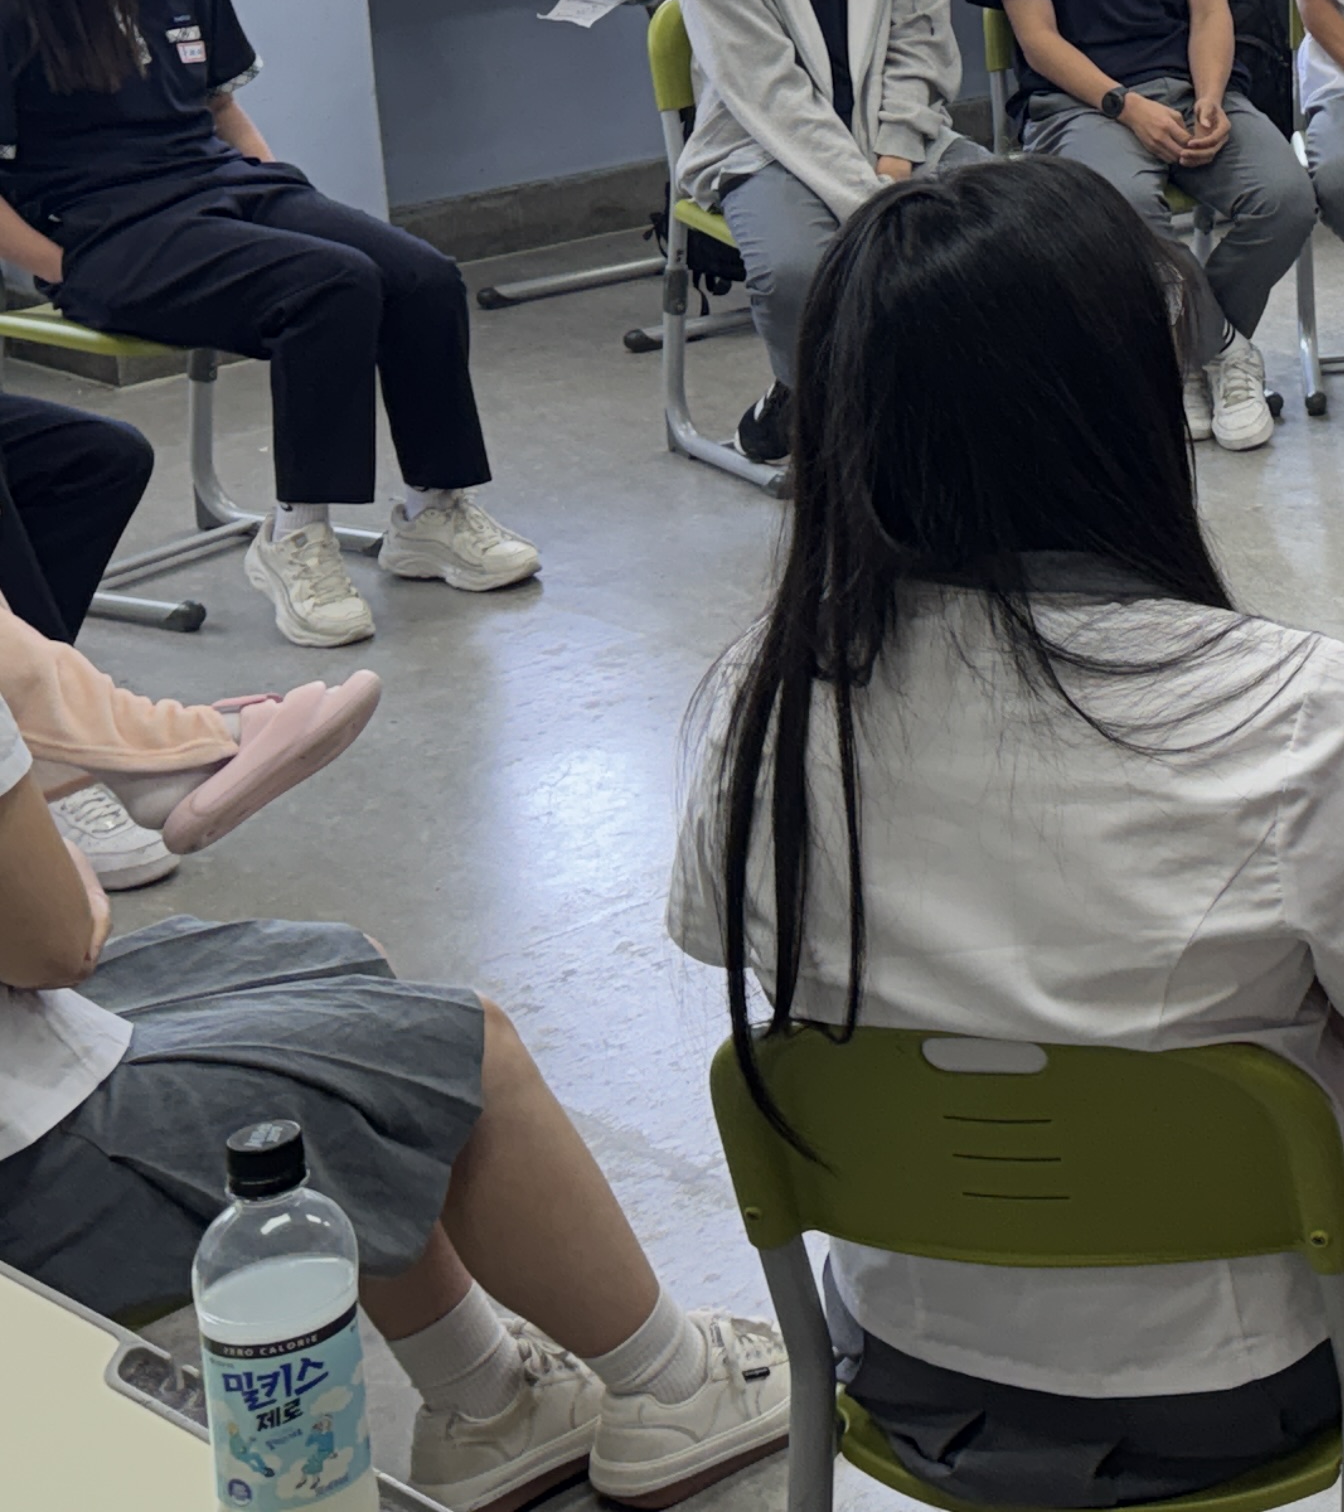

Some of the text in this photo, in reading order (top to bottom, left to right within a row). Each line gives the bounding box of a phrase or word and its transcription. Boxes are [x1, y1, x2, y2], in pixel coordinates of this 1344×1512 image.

[222, 1334, 318, 1357] ZERO CALORIE
[221, 1357, 330, 1412] 밀키스
[255, 1397, 304, 1432] 제로
